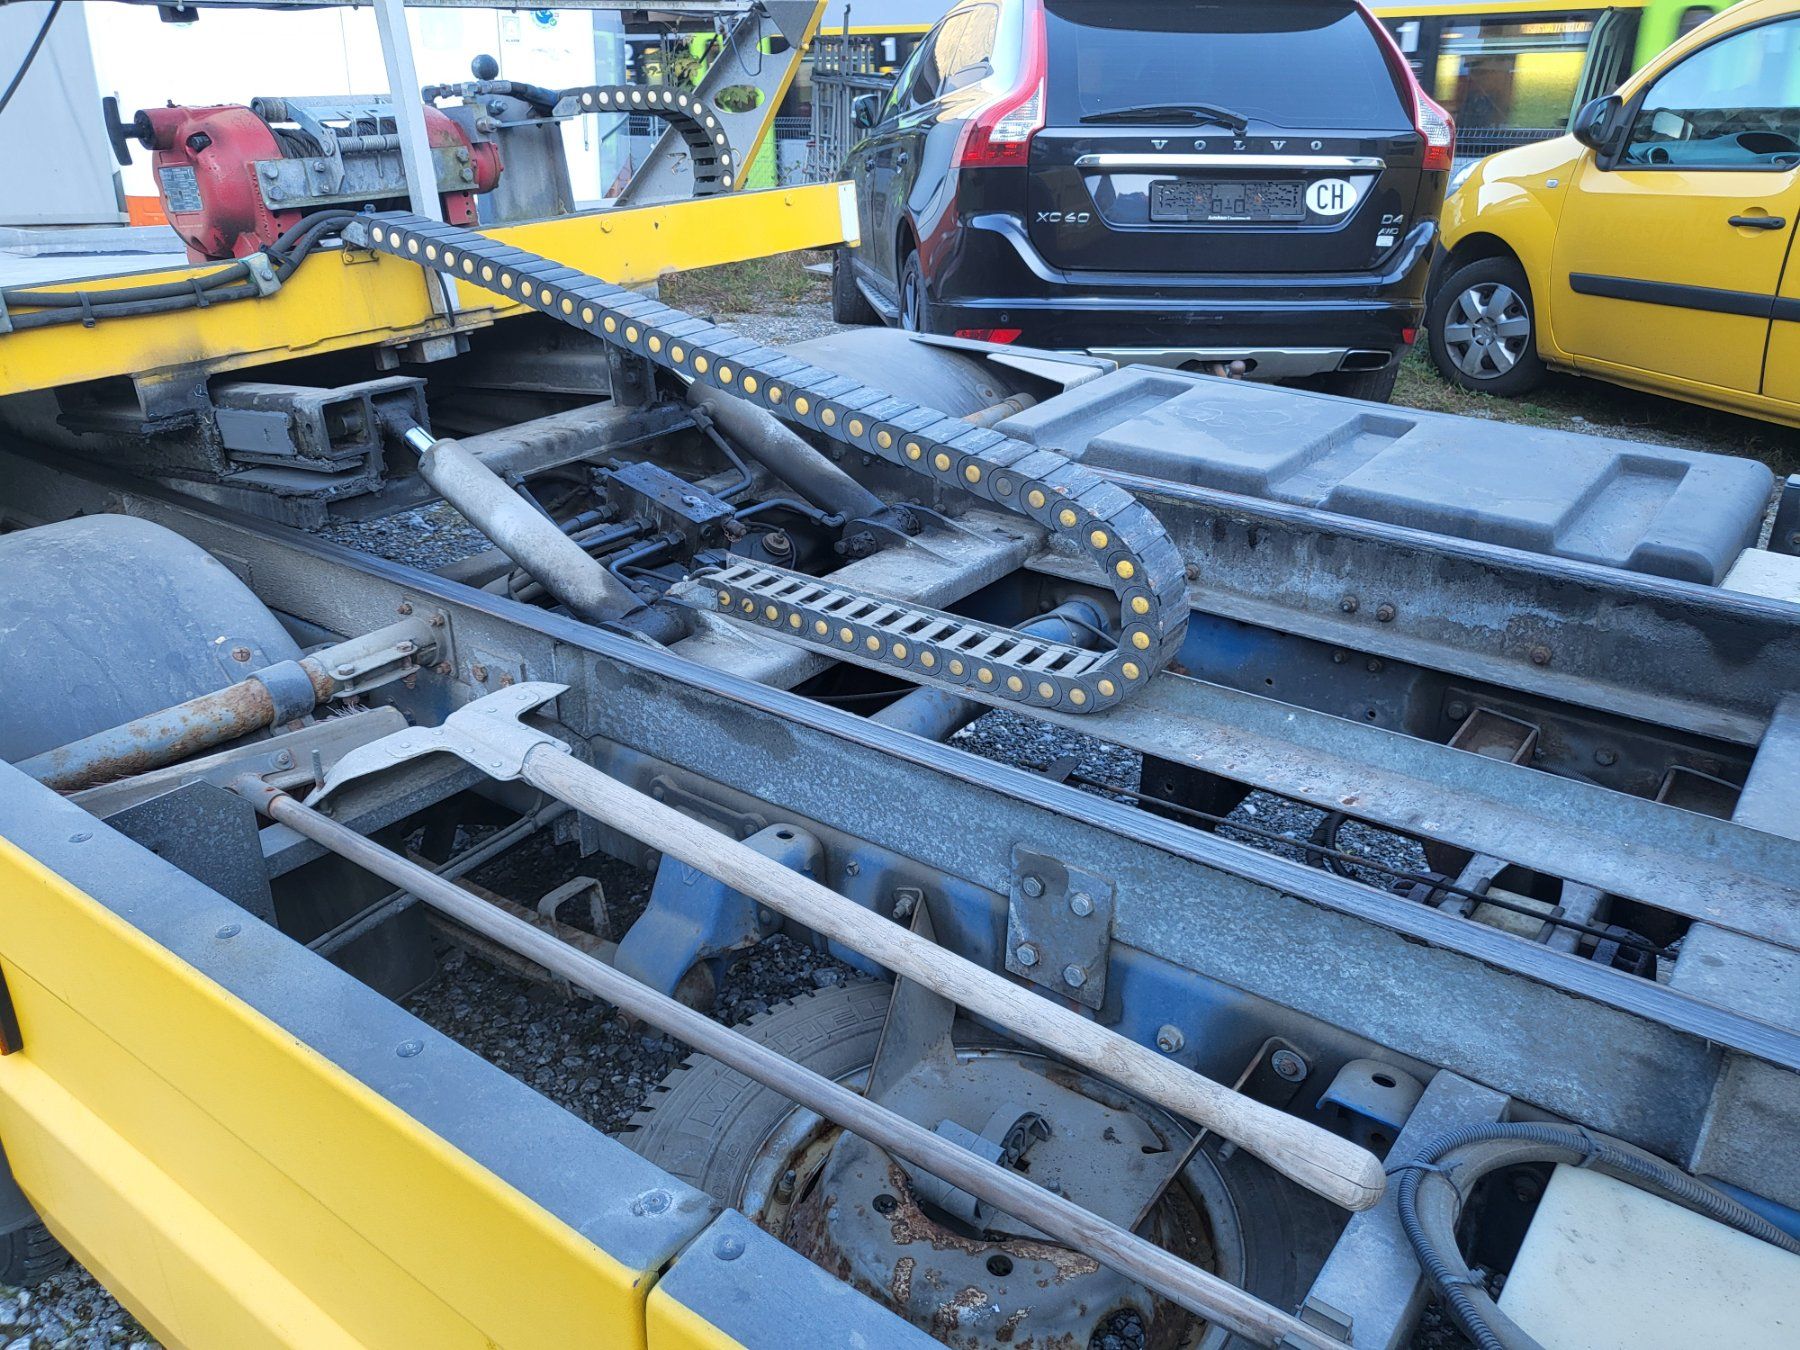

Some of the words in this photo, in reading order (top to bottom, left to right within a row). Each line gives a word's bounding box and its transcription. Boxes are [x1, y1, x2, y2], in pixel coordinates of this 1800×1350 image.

[1151, 139, 1322, 151] VOLVO
[1316, 183, 1344, 210] CH
[1380, 213, 1405, 225] D4
